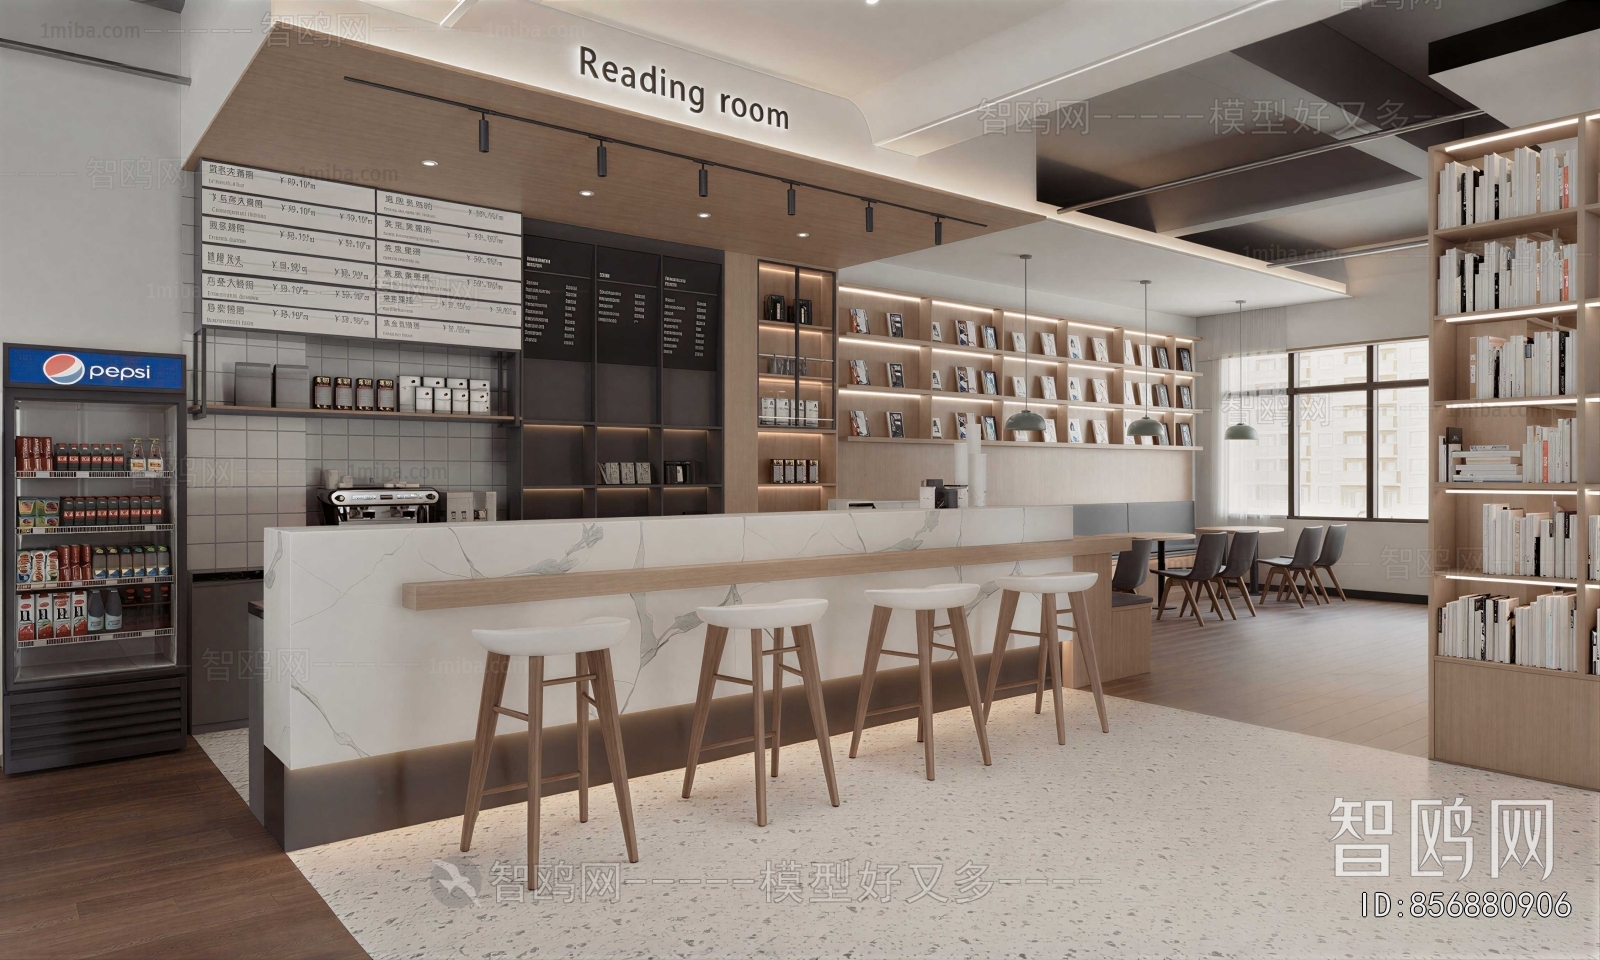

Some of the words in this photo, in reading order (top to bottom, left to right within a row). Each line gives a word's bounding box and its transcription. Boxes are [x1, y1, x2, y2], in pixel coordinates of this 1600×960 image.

[579, 45, 705, 114] Reading
[720, 92, 790, 130] room
[89, 364, 151, 381] pepsi
